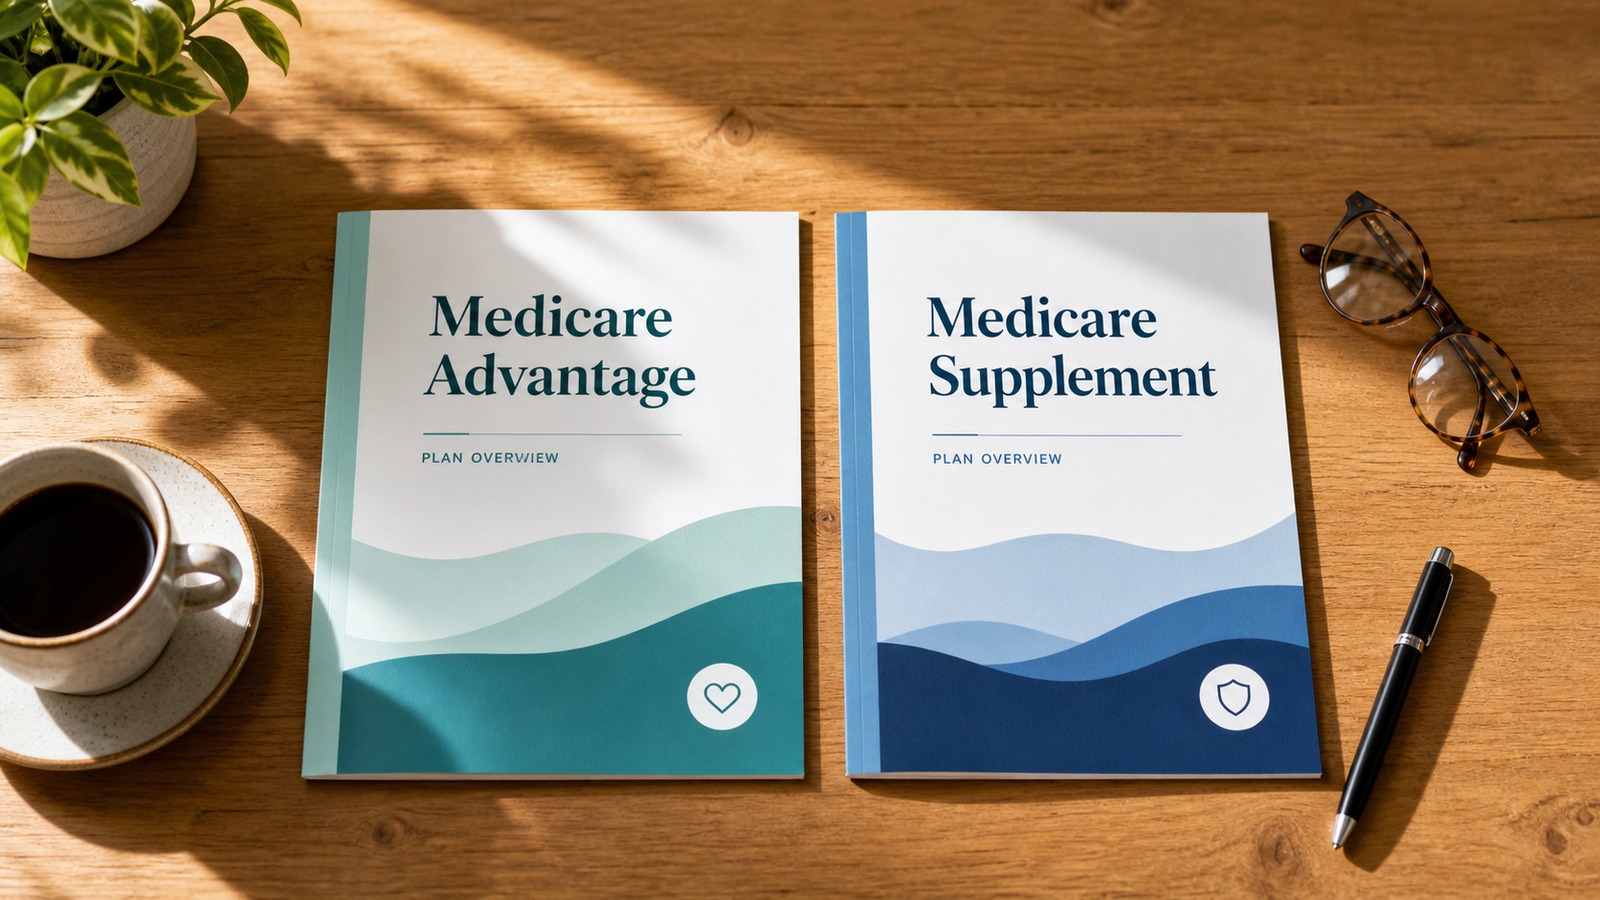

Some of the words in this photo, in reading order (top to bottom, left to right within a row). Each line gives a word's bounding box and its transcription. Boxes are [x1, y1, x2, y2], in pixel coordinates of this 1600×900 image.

[429, 294, 673, 338] Medicare
[926, 295, 1158, 338] Medicare
[422, 351, 696, 409] Advantage
[929, 353, 1219, 409] Supplement
[421, 452, 463, 464] PLAN
[933, 453, 973, 465] PLAN
[981, 453, 1063, 465] OVERVIEW
